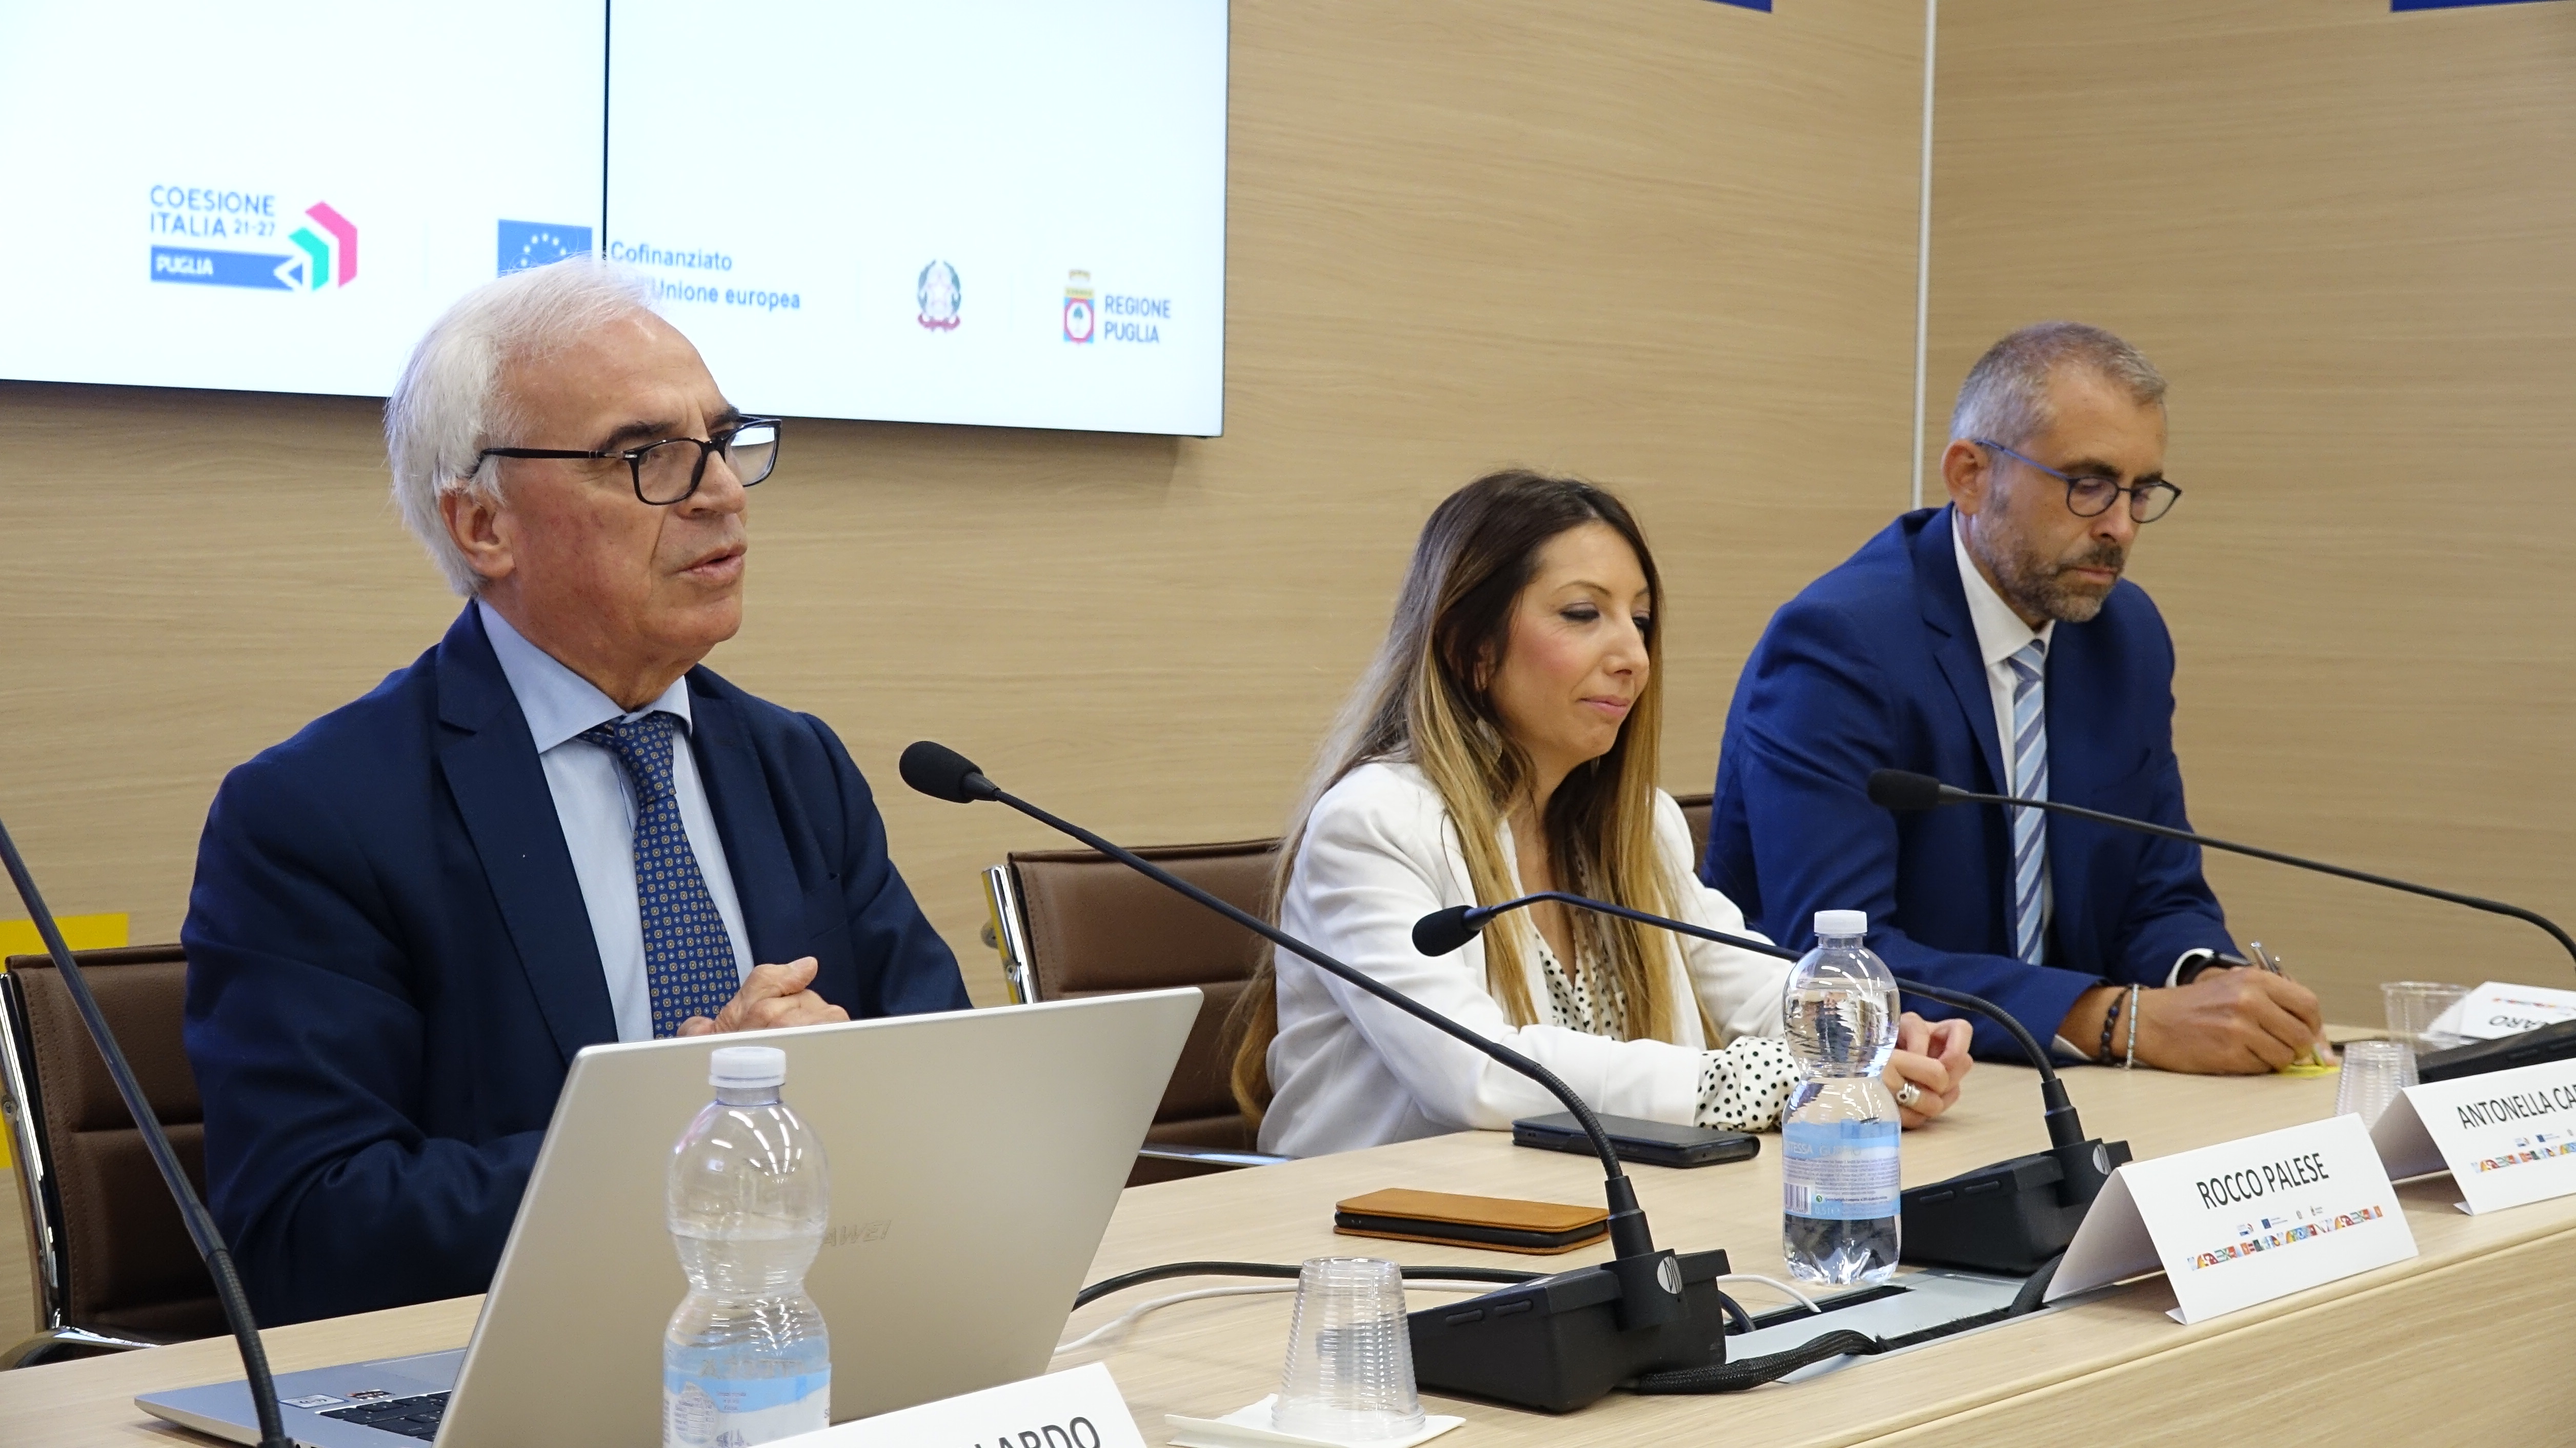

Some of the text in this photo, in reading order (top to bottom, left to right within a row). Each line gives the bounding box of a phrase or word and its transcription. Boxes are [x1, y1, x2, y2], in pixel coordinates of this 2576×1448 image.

[150, 185, 275, 217] COESIONE
[150, 211, 276, 238] ITALIA 21-27
[155, 255, 214, 275] PUGLIA
[610, 240, 733, 272] Cofinanziato
[642, 277, 801, 311] Unione europea
[1104, 294, 1171, 319] REGIONE
[1104, 321, 1160, 344] PUGLIA
[2457, 1090, 2557, 1130] ANTONELLA
[2196, 1152, 2329, 1210] ROCCO PALESE
